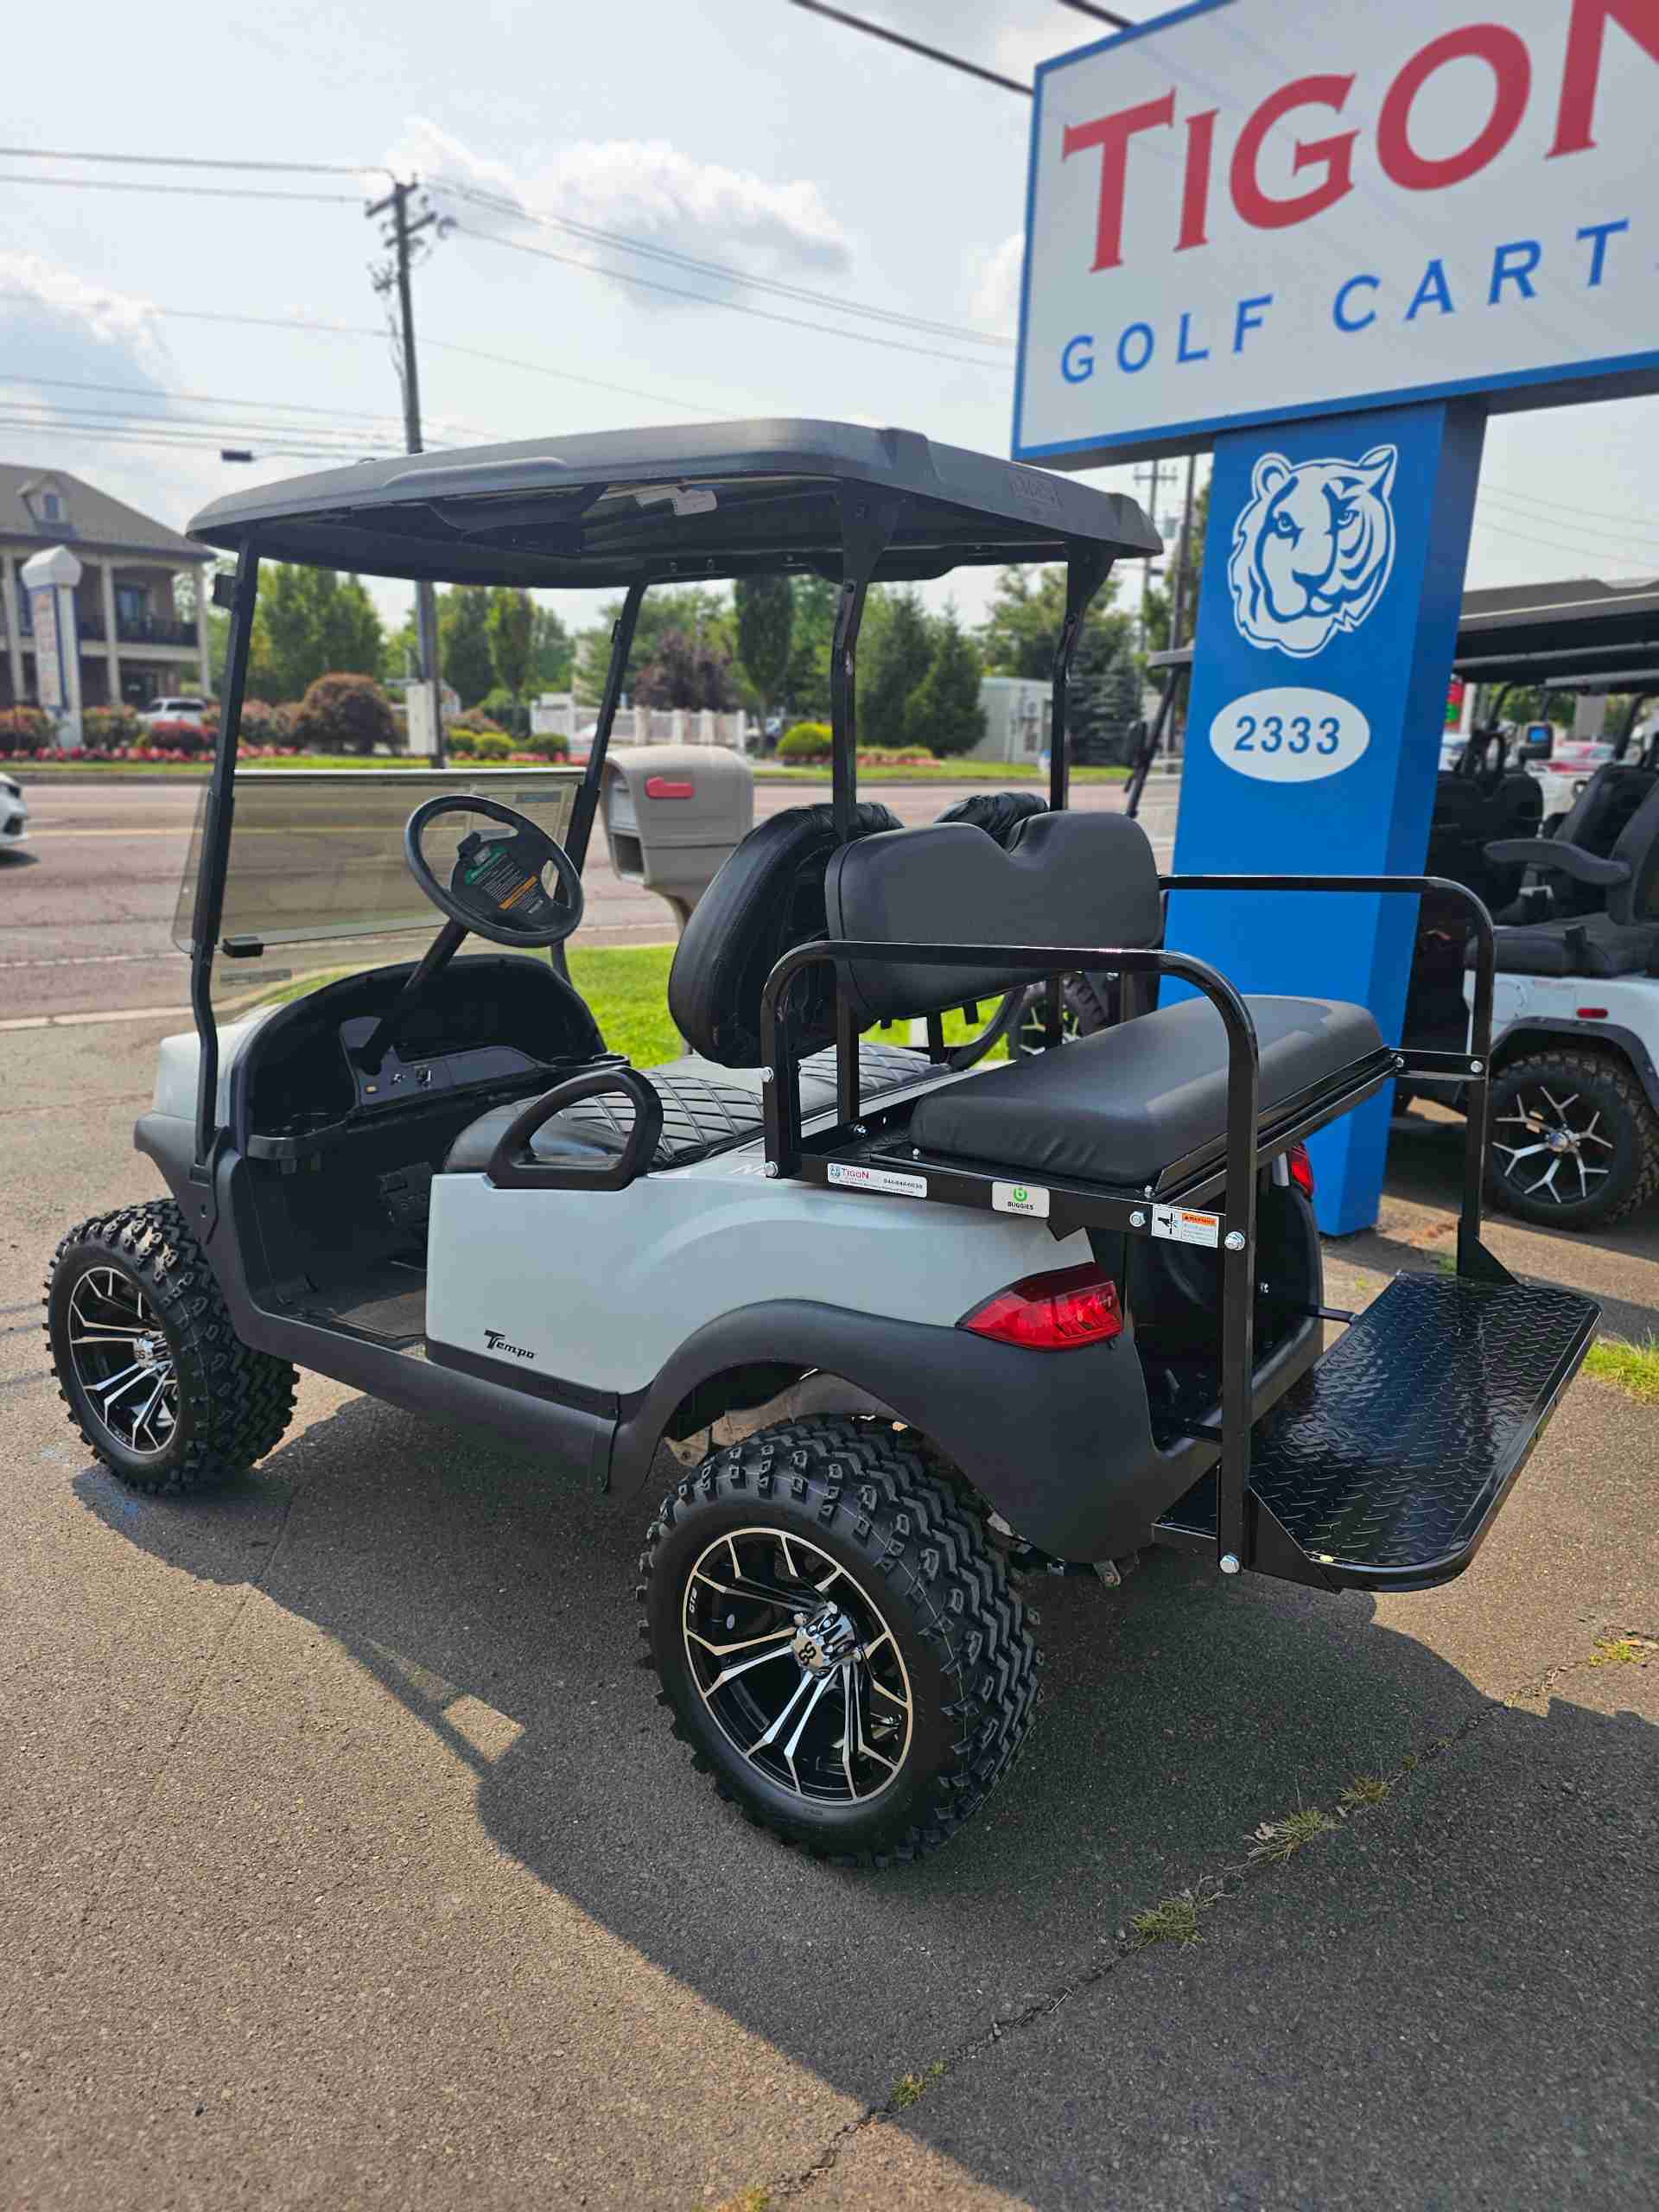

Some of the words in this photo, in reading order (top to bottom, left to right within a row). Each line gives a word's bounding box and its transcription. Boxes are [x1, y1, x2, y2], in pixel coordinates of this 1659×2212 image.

[1060, 295, 1274, 385] GOLF
[1332, 218, 1630, 333] CART
[1233, 715, 1341, 755] 2333
[842, 1167, 871, 1179] TIGON
[1007, 1201, 1033, 1211] BUGGIES
[484, 1329, 535, 1358] Tempo
